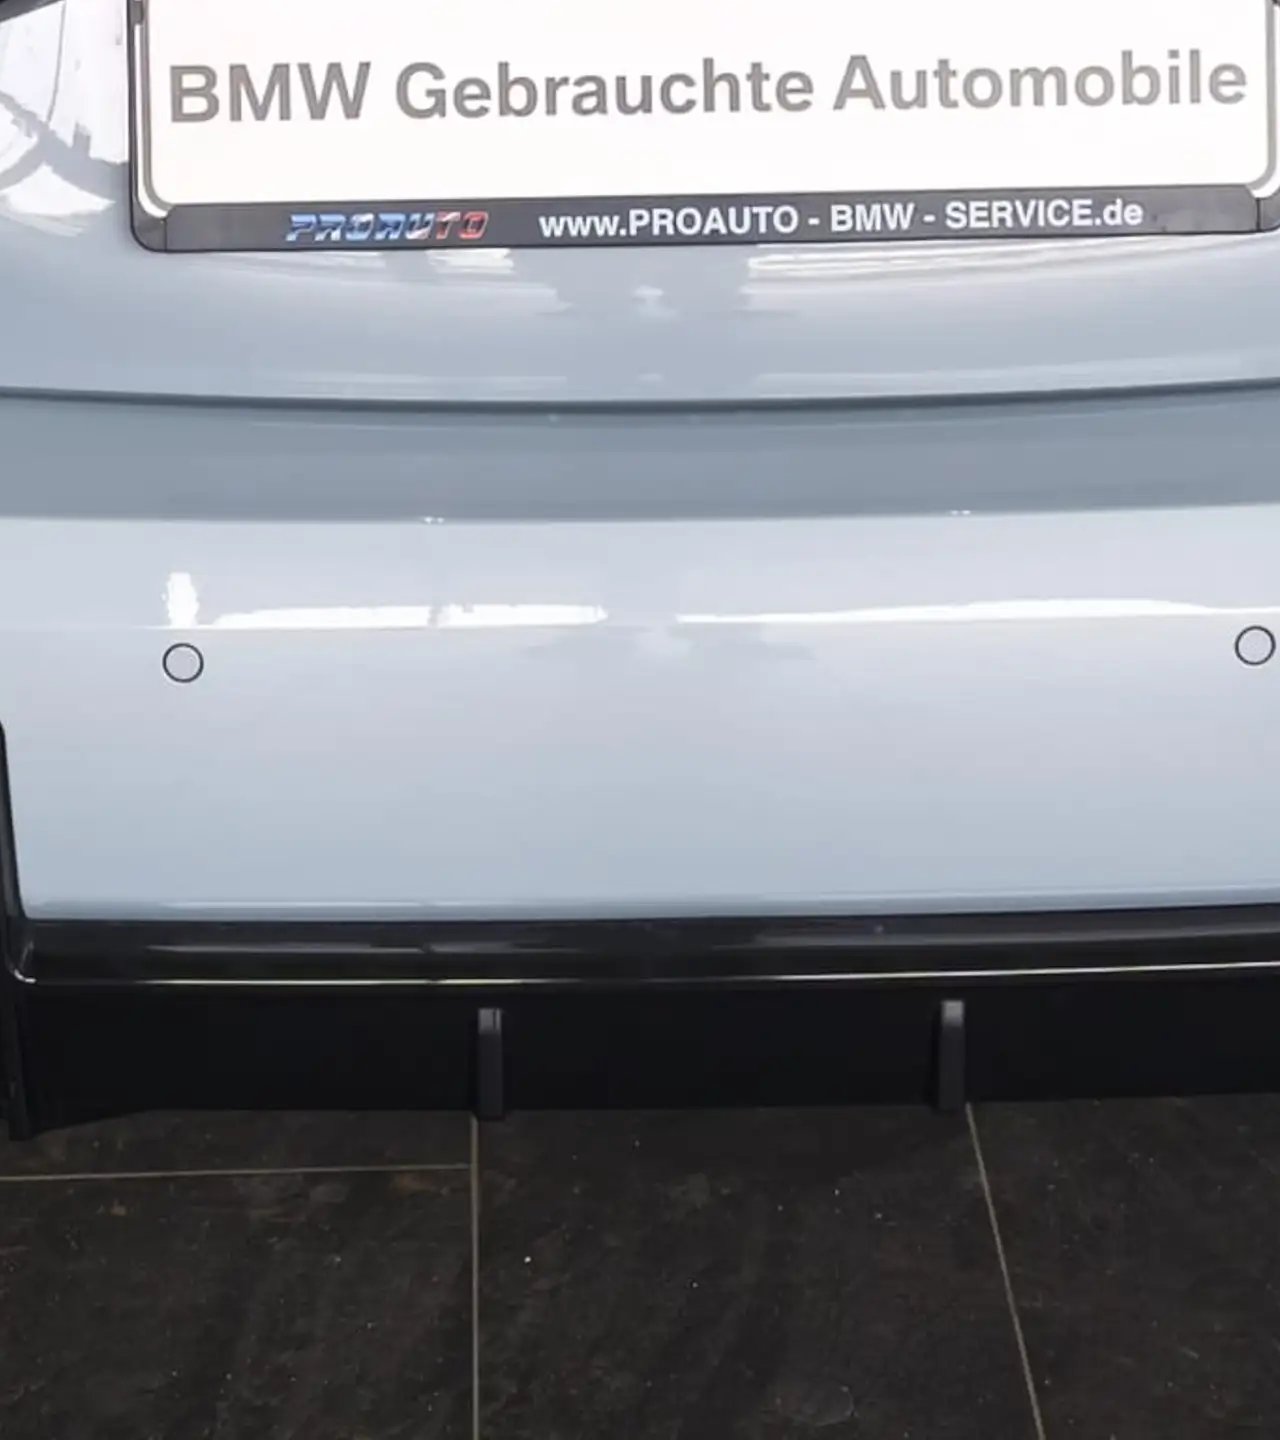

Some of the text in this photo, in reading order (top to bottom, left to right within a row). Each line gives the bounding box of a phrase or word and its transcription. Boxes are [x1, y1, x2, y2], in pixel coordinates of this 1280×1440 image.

[169, 49, 1248, 123] BMW Gebrauchte Automobile
[285, 210, 489, 242] PROAUTO
[830, 203, 915, 233] BMW
[944, 198, 1144, 230] SERVICE.de
